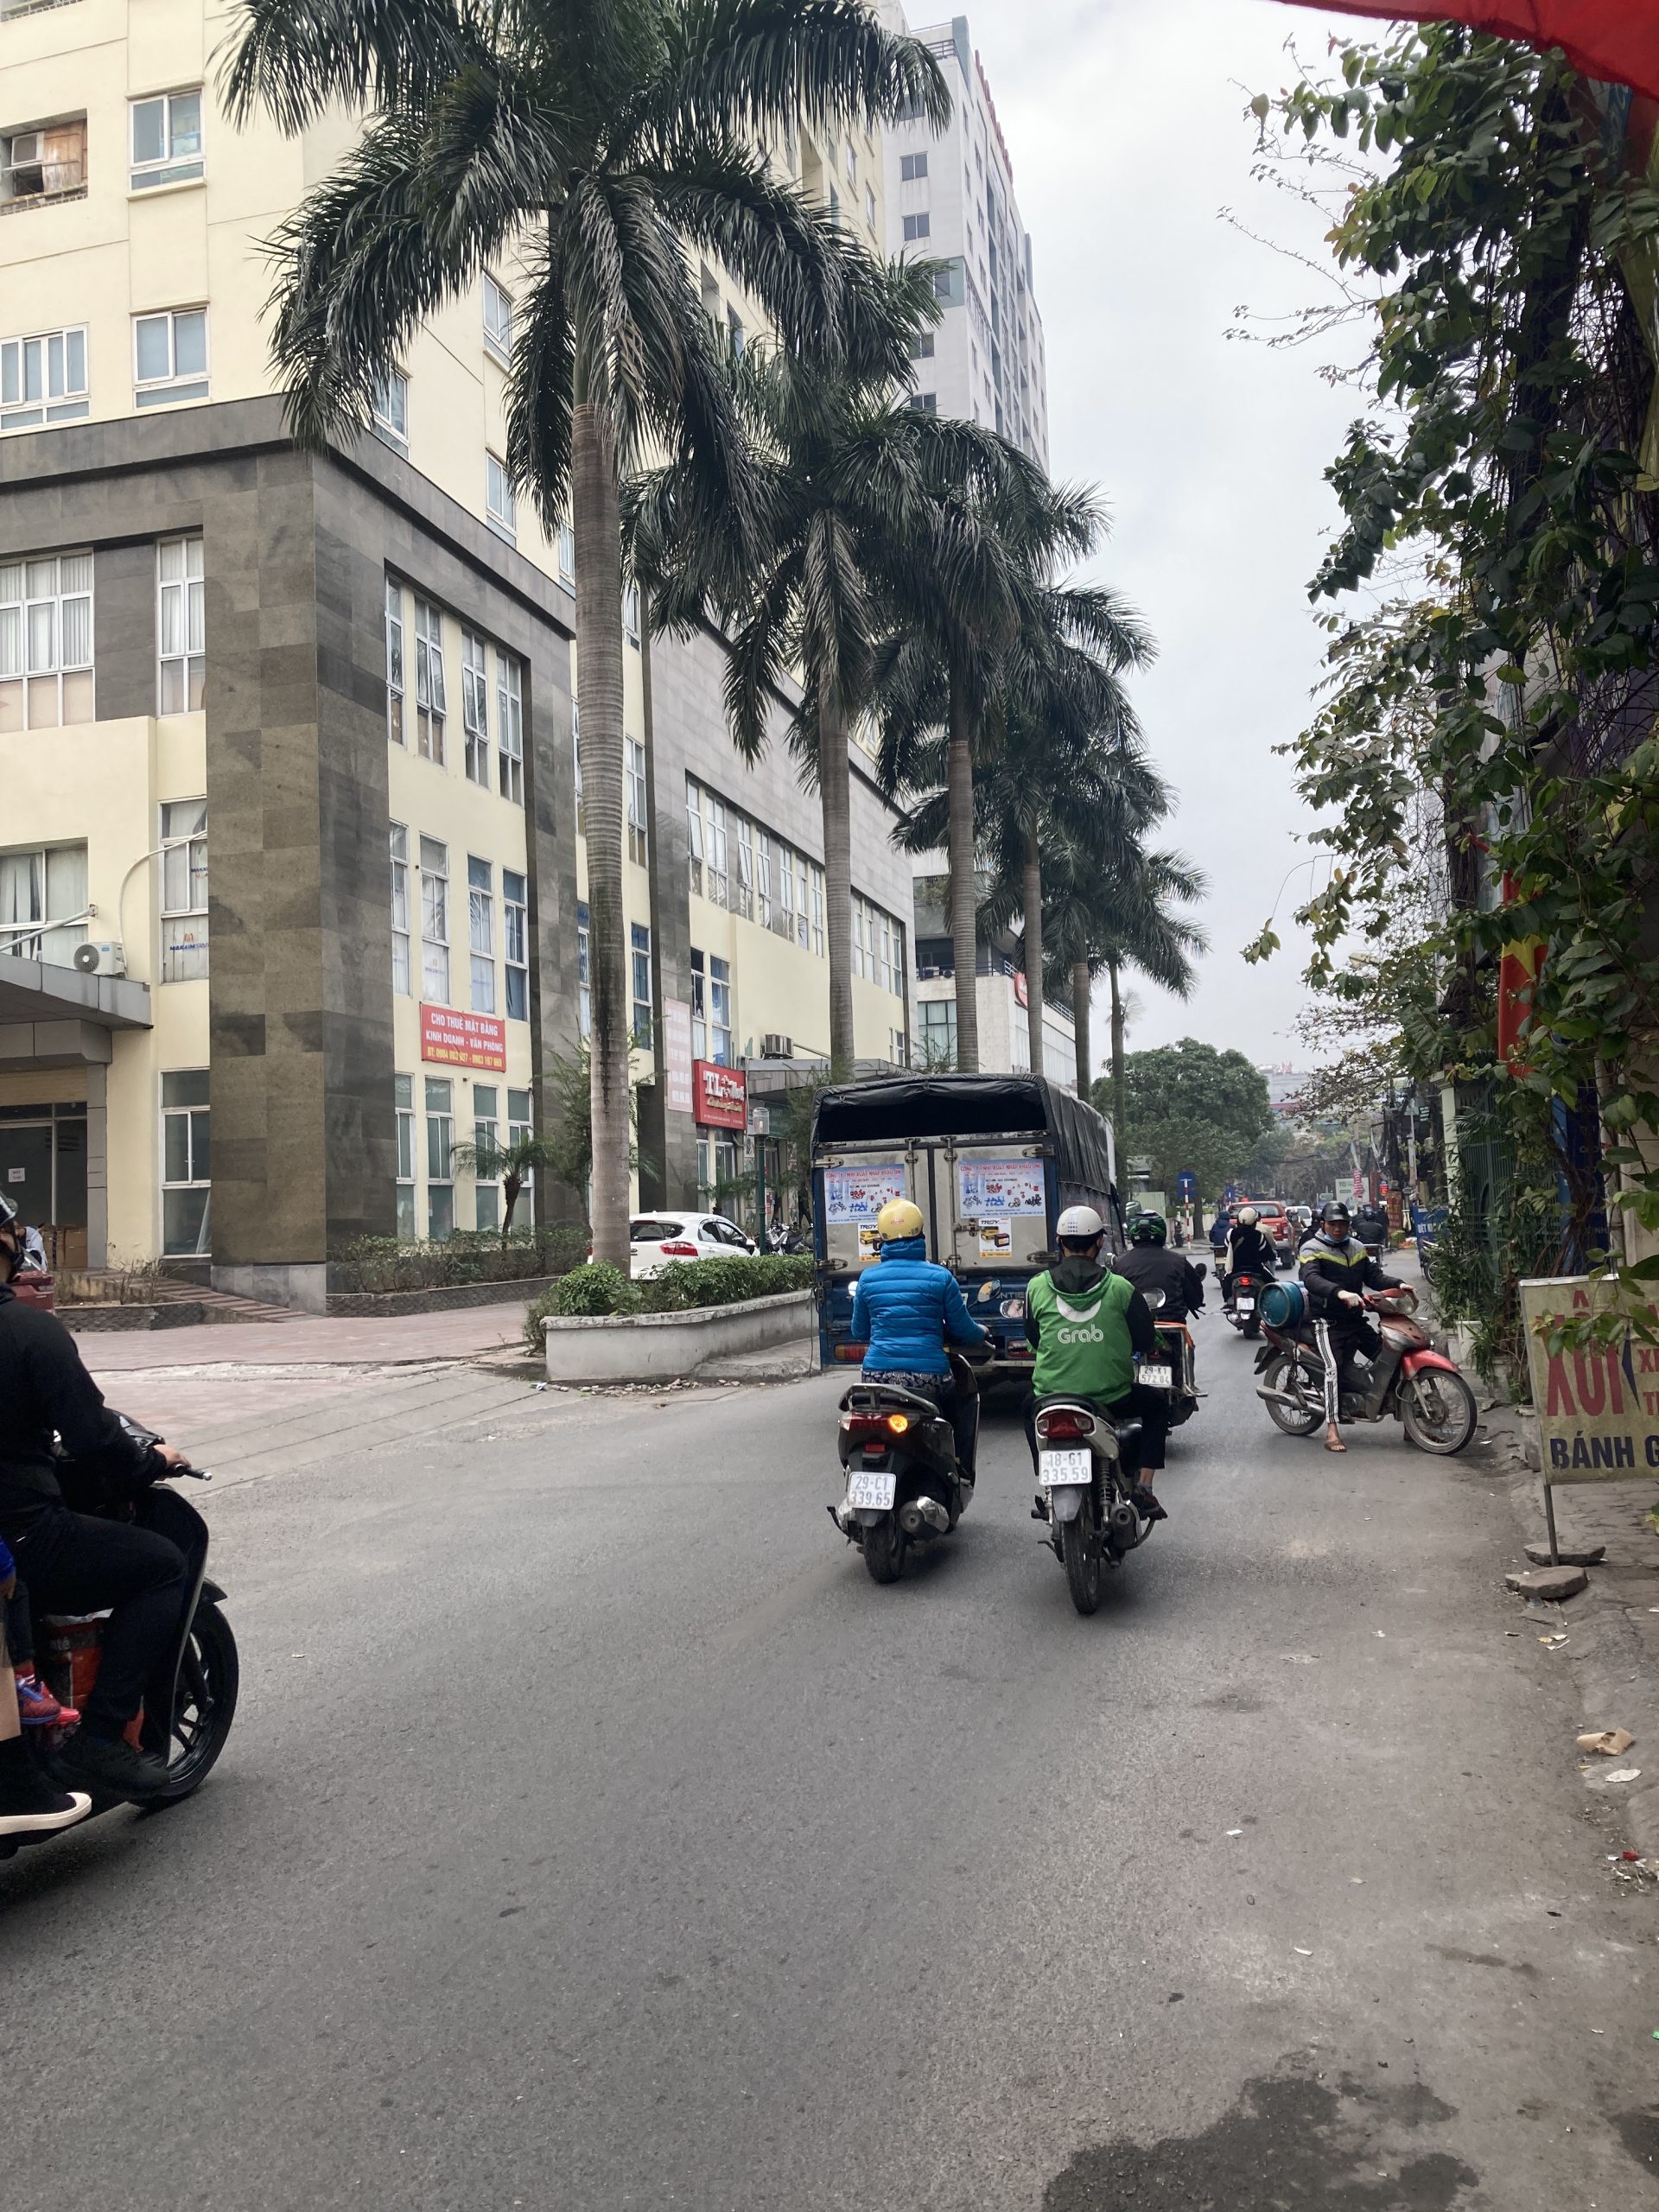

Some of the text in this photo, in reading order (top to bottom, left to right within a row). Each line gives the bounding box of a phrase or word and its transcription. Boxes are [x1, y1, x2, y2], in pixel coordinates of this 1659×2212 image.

[431, 1013, 445, 1026] CHO
[447, 1016, 463, 1030] THUÊ
[465, 1019, 479, 1034] MẶT
[426, 1030, 442, 1041] KINH
[443, 1033, 464, 1046] DOANH
[470, 1038, 482, 1049] VĂN
[484, 1040, 503, 1052] PHÒNG
[1058, 1324, 1104, 1344] Grab
[1144, 1367, 1166, 1375] 29-K1
[1550, 1430, 1635, 1469] BÁNH
[1049, 1452, 1082, 1467] 18-G1
[855, 1475, 888, 1491] 29-C1
[1043, 1467, 1088, 1483] 335.59
[851, 1491, 890, 1506] 339.65
